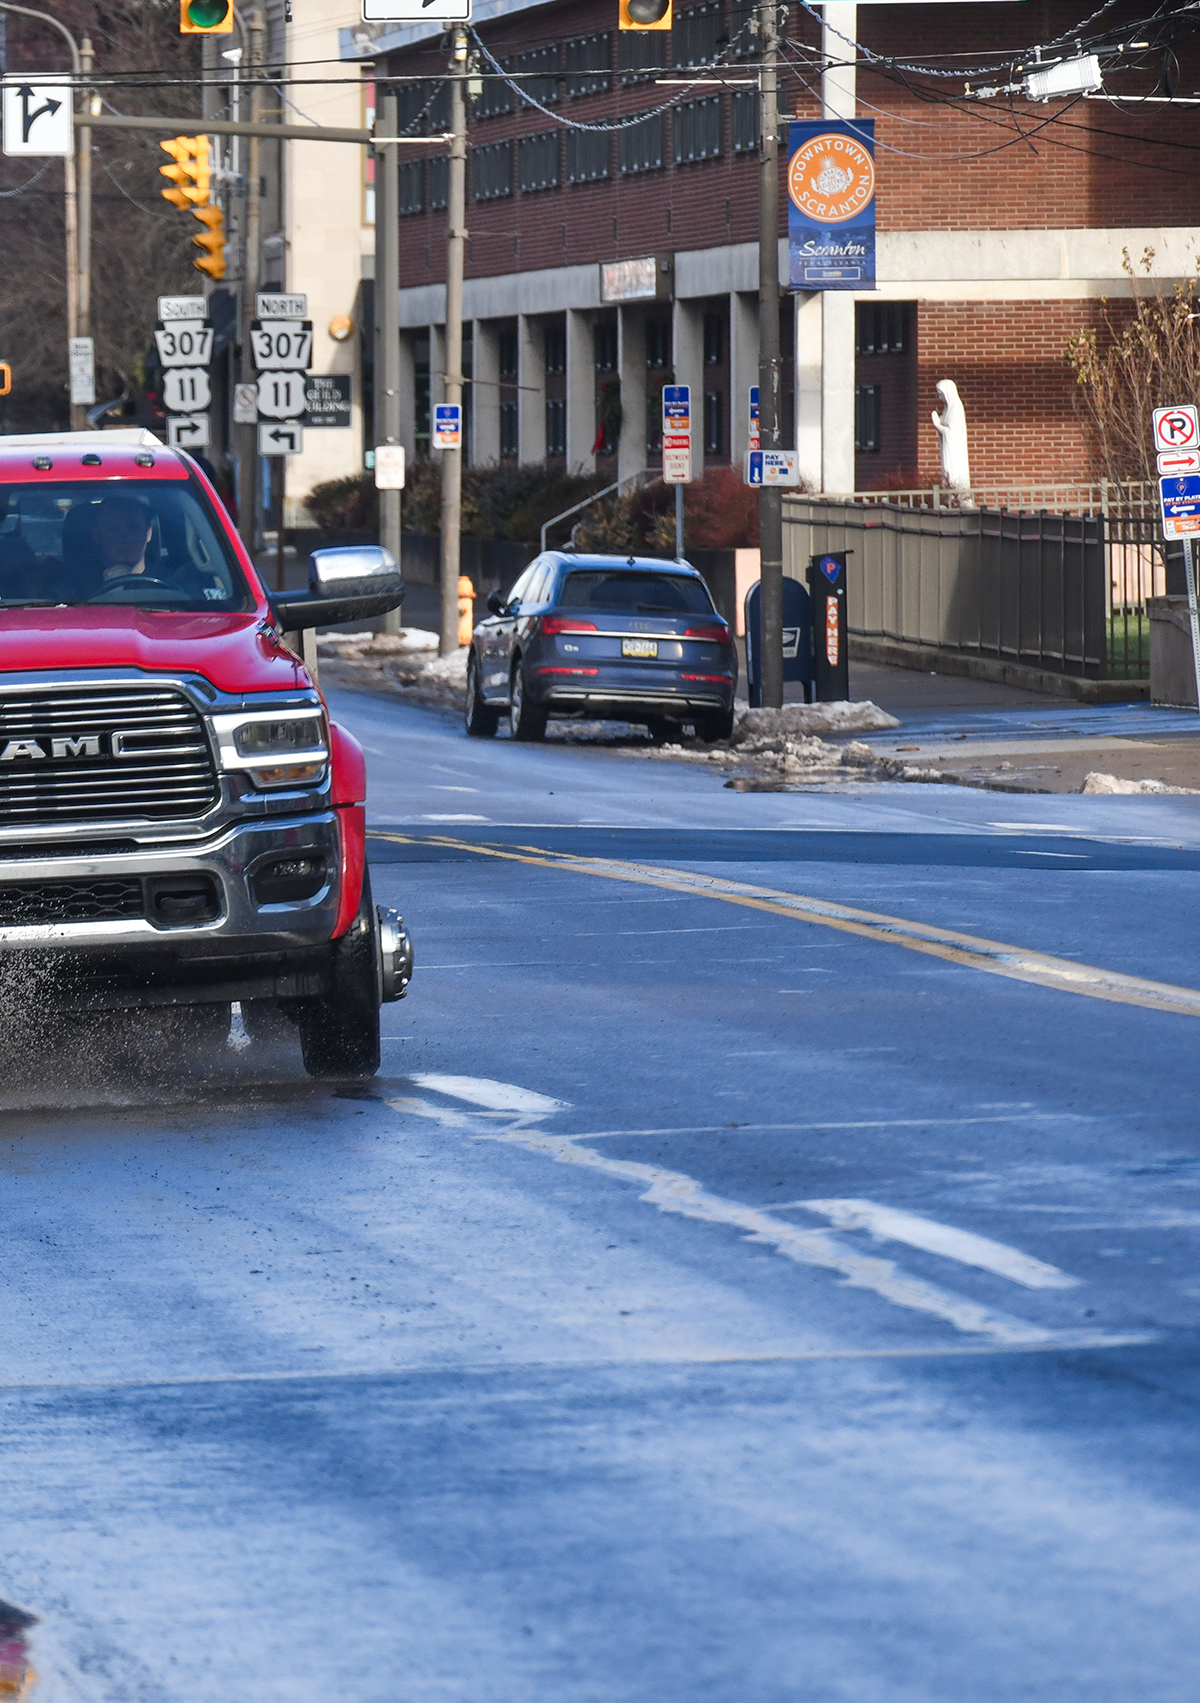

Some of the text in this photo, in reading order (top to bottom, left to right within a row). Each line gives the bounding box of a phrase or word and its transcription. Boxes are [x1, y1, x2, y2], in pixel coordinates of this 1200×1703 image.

[793, 140, 865, 182] DOWNTOWN
[799, 175, 870, 216] SCRANTON
[799, 240, 865, 257] Scranton
[164, 301, 205, 317] SOUTH
[261, 299, 304, 314] NORTH
[162, 331, 208, 357] 307
[259, 333, 307, 359] 307
[178, 378, 197, 401] 11
[272, 381, 292, 407] 11
[828, 597, 838, 624] PAY
[828, 628, 839, 664] HERE
